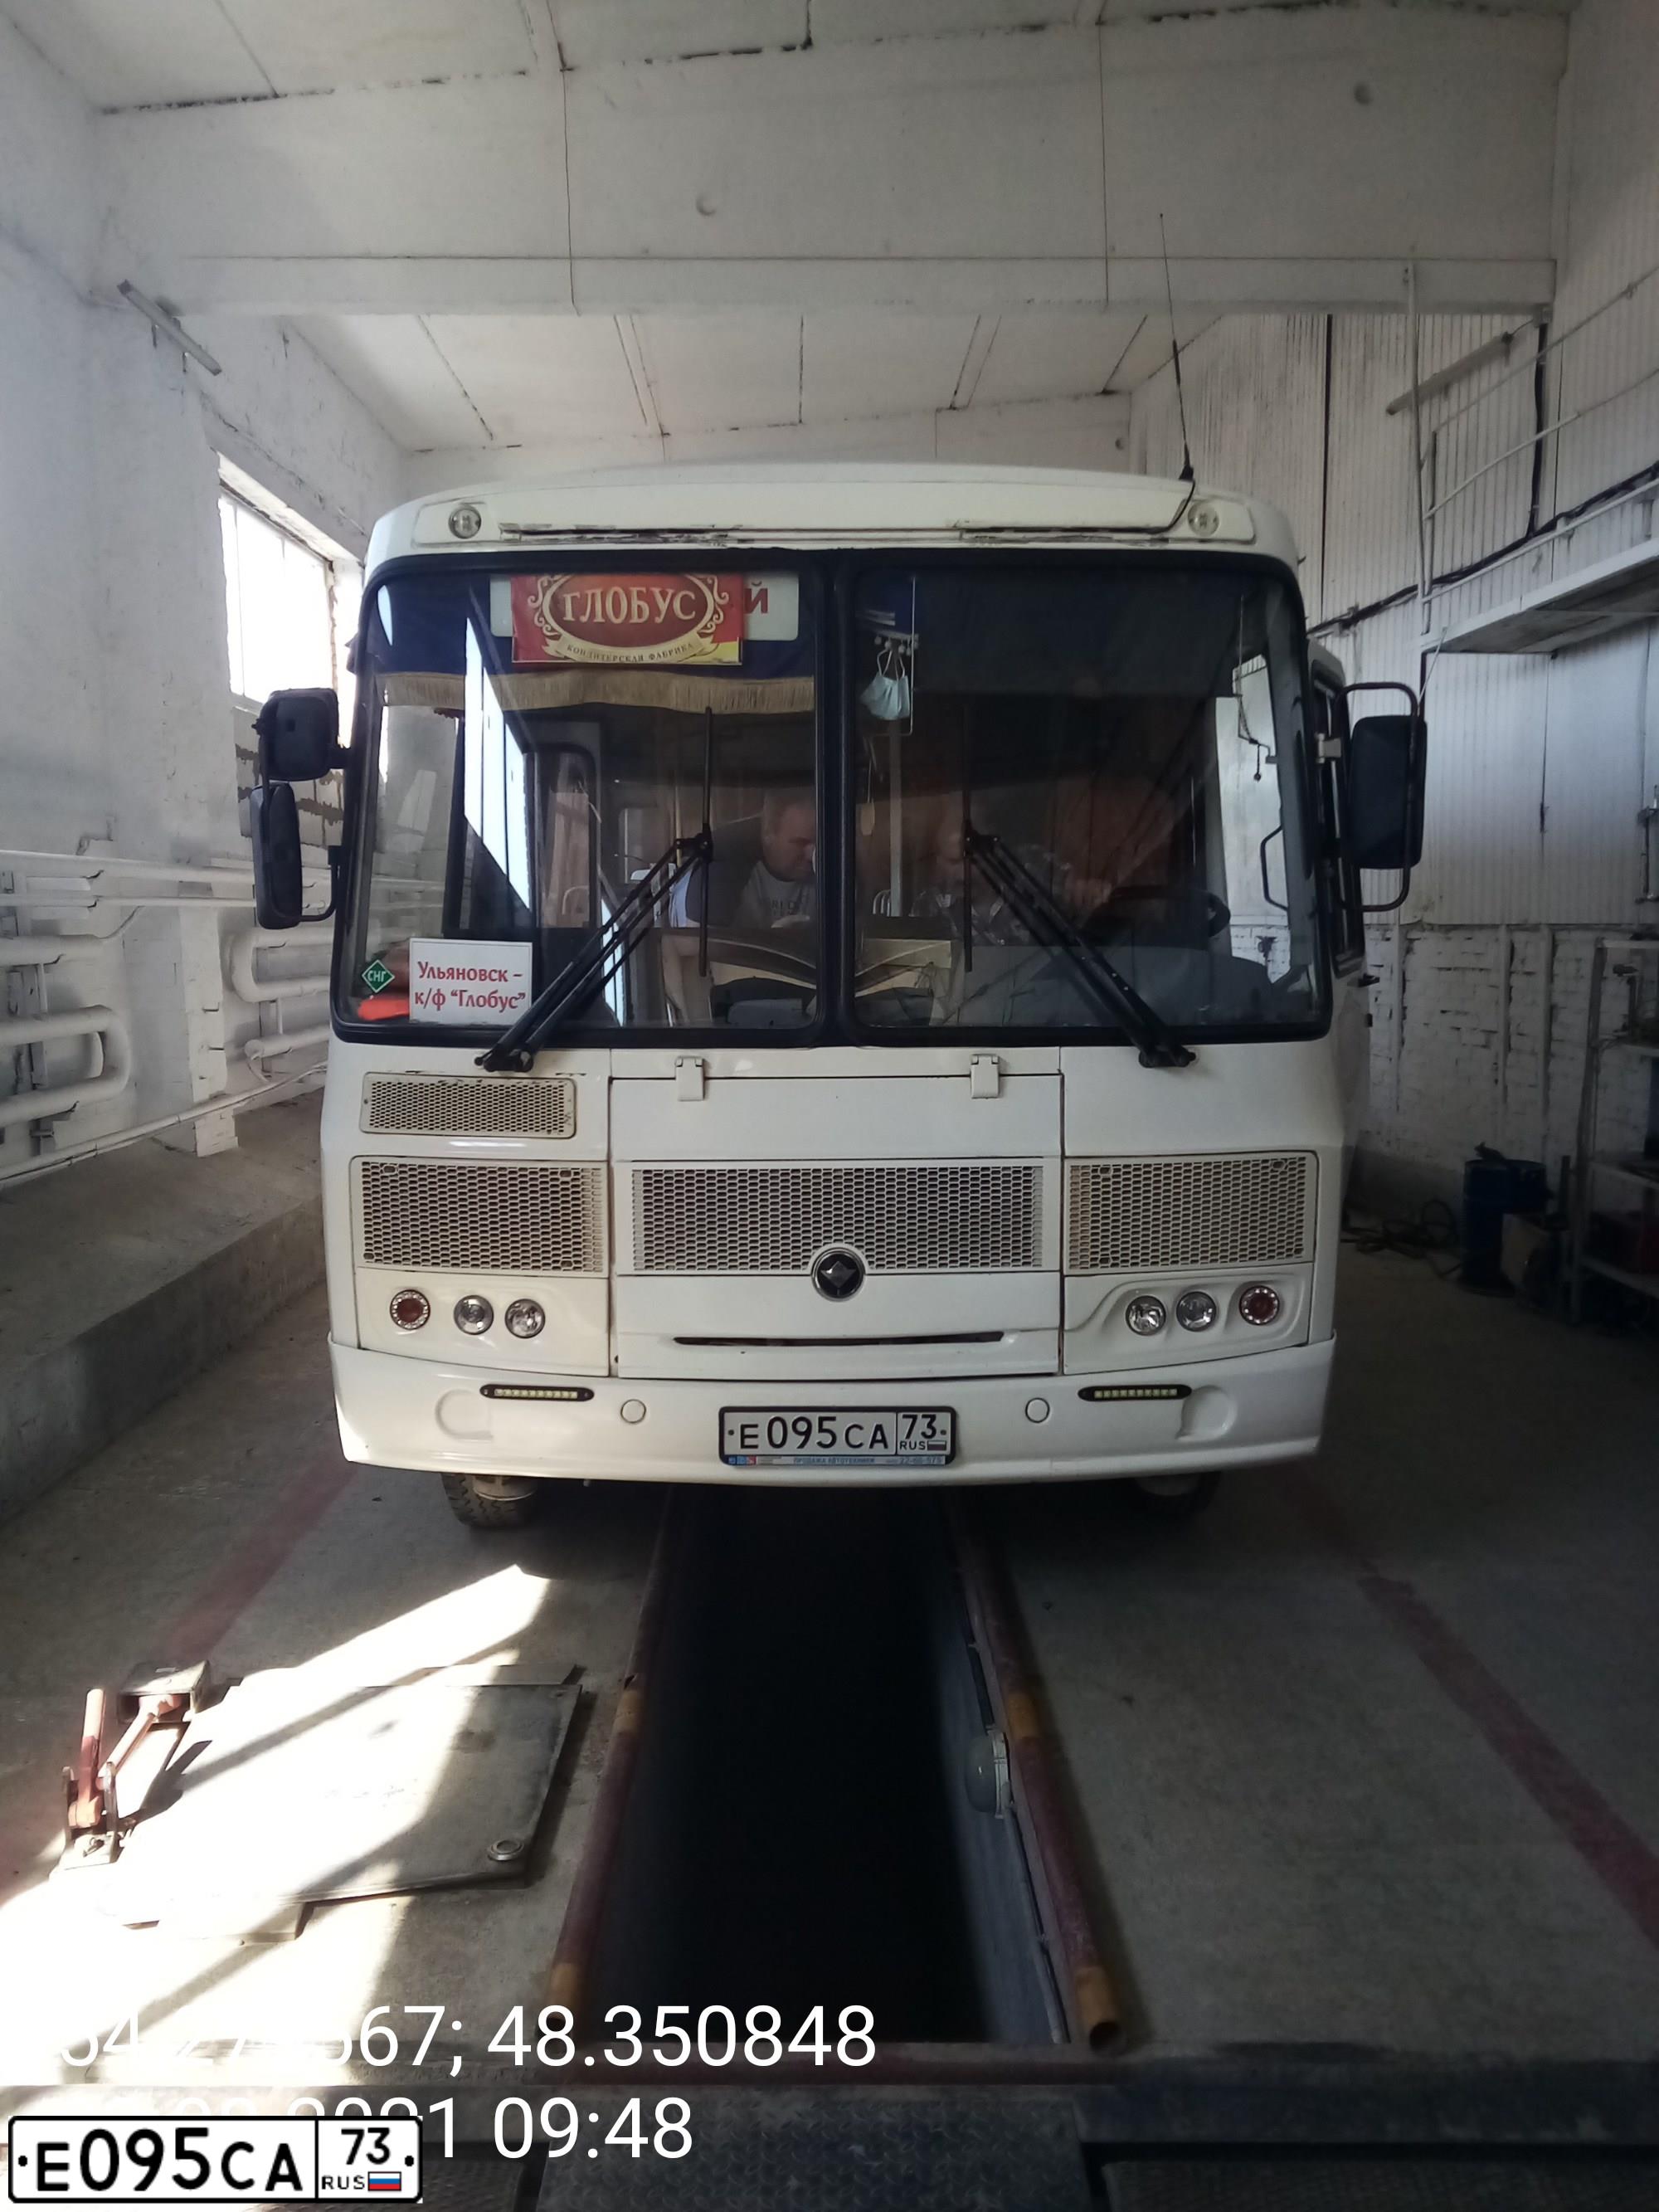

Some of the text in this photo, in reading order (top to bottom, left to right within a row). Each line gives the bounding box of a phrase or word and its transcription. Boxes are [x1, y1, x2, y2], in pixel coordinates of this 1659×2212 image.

[562, 586, 696, 624] ГЛОБУС
[649, 643, 695, 660] ФАБРИКА
[417, 961, 508, 982] Ульяновск
[415, 988, 445, 1011] к/ф
[902, 1414, 937, 1440] 73
[899, 1440, 926, 1450] RUS
